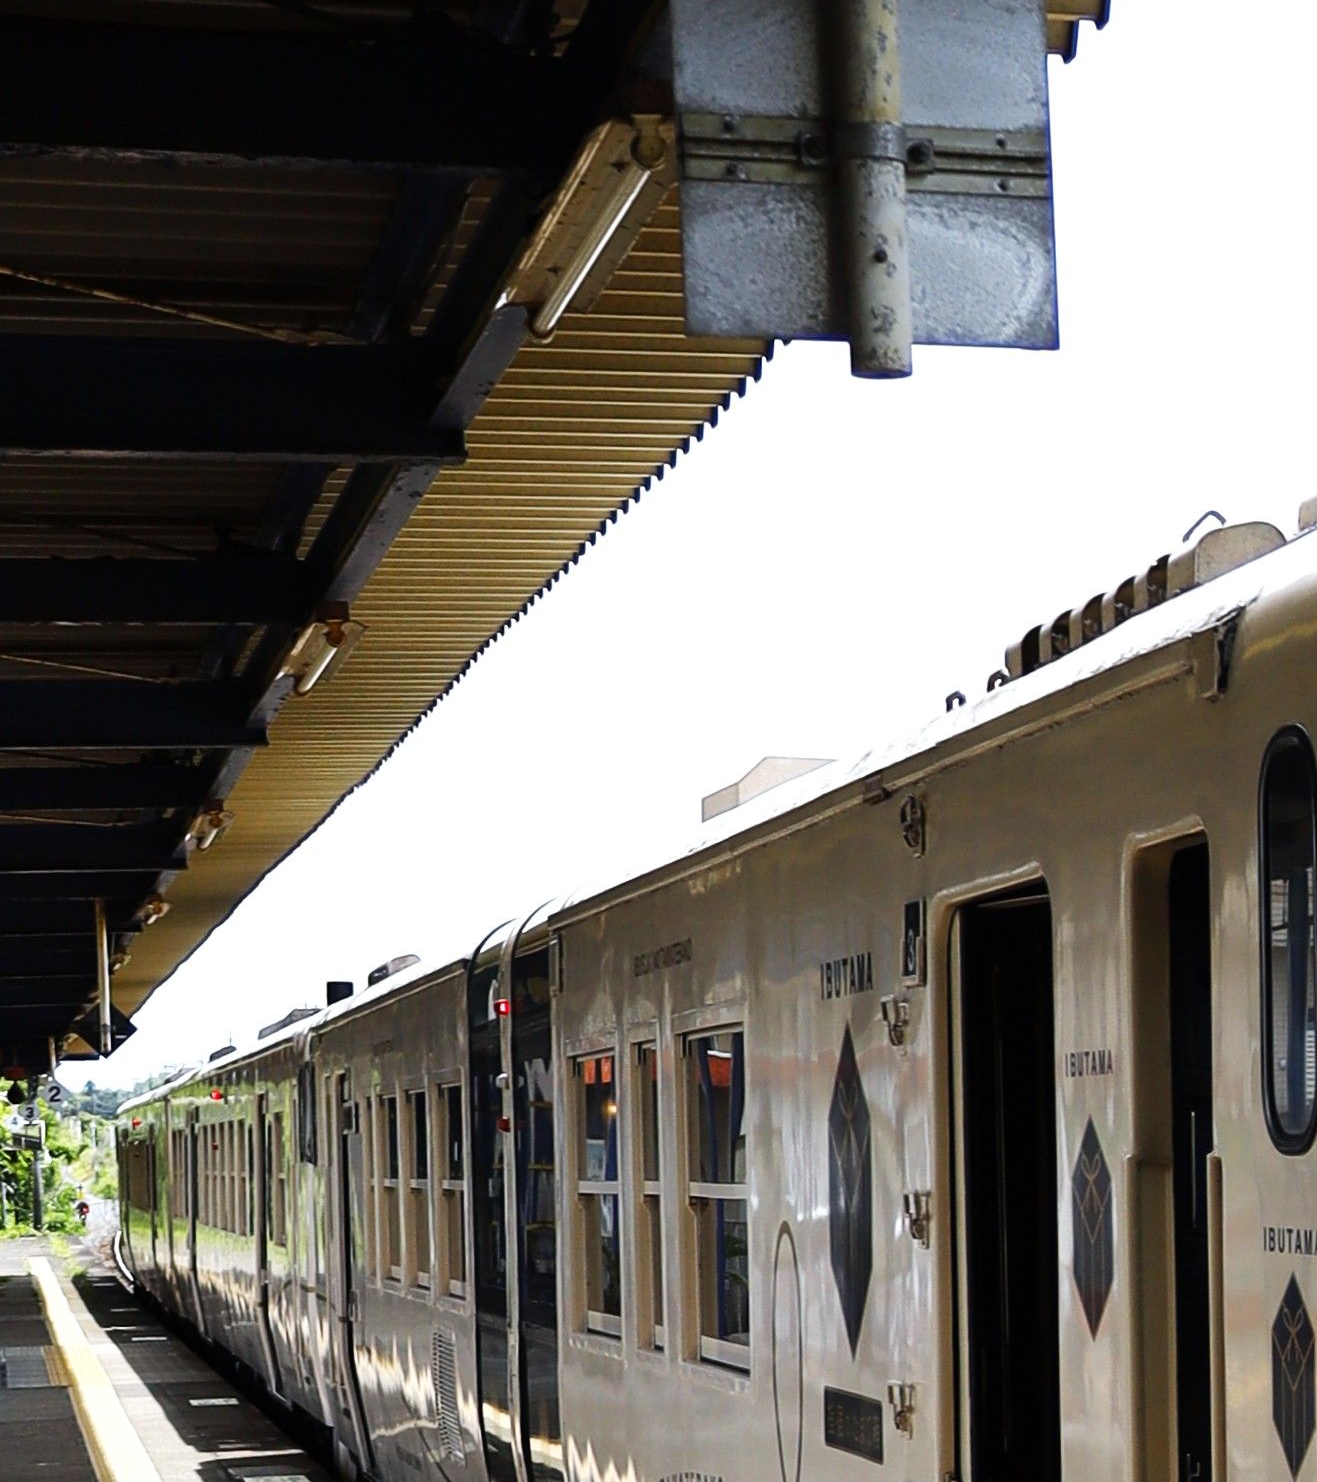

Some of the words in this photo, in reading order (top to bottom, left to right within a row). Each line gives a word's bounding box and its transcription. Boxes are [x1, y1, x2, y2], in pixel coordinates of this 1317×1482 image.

[820, 951, 873, 1000] IBUTAMA
[1065, 1049, 1114, 1077] IBUTAMA
[48, 1086, 61, 1102] 2
